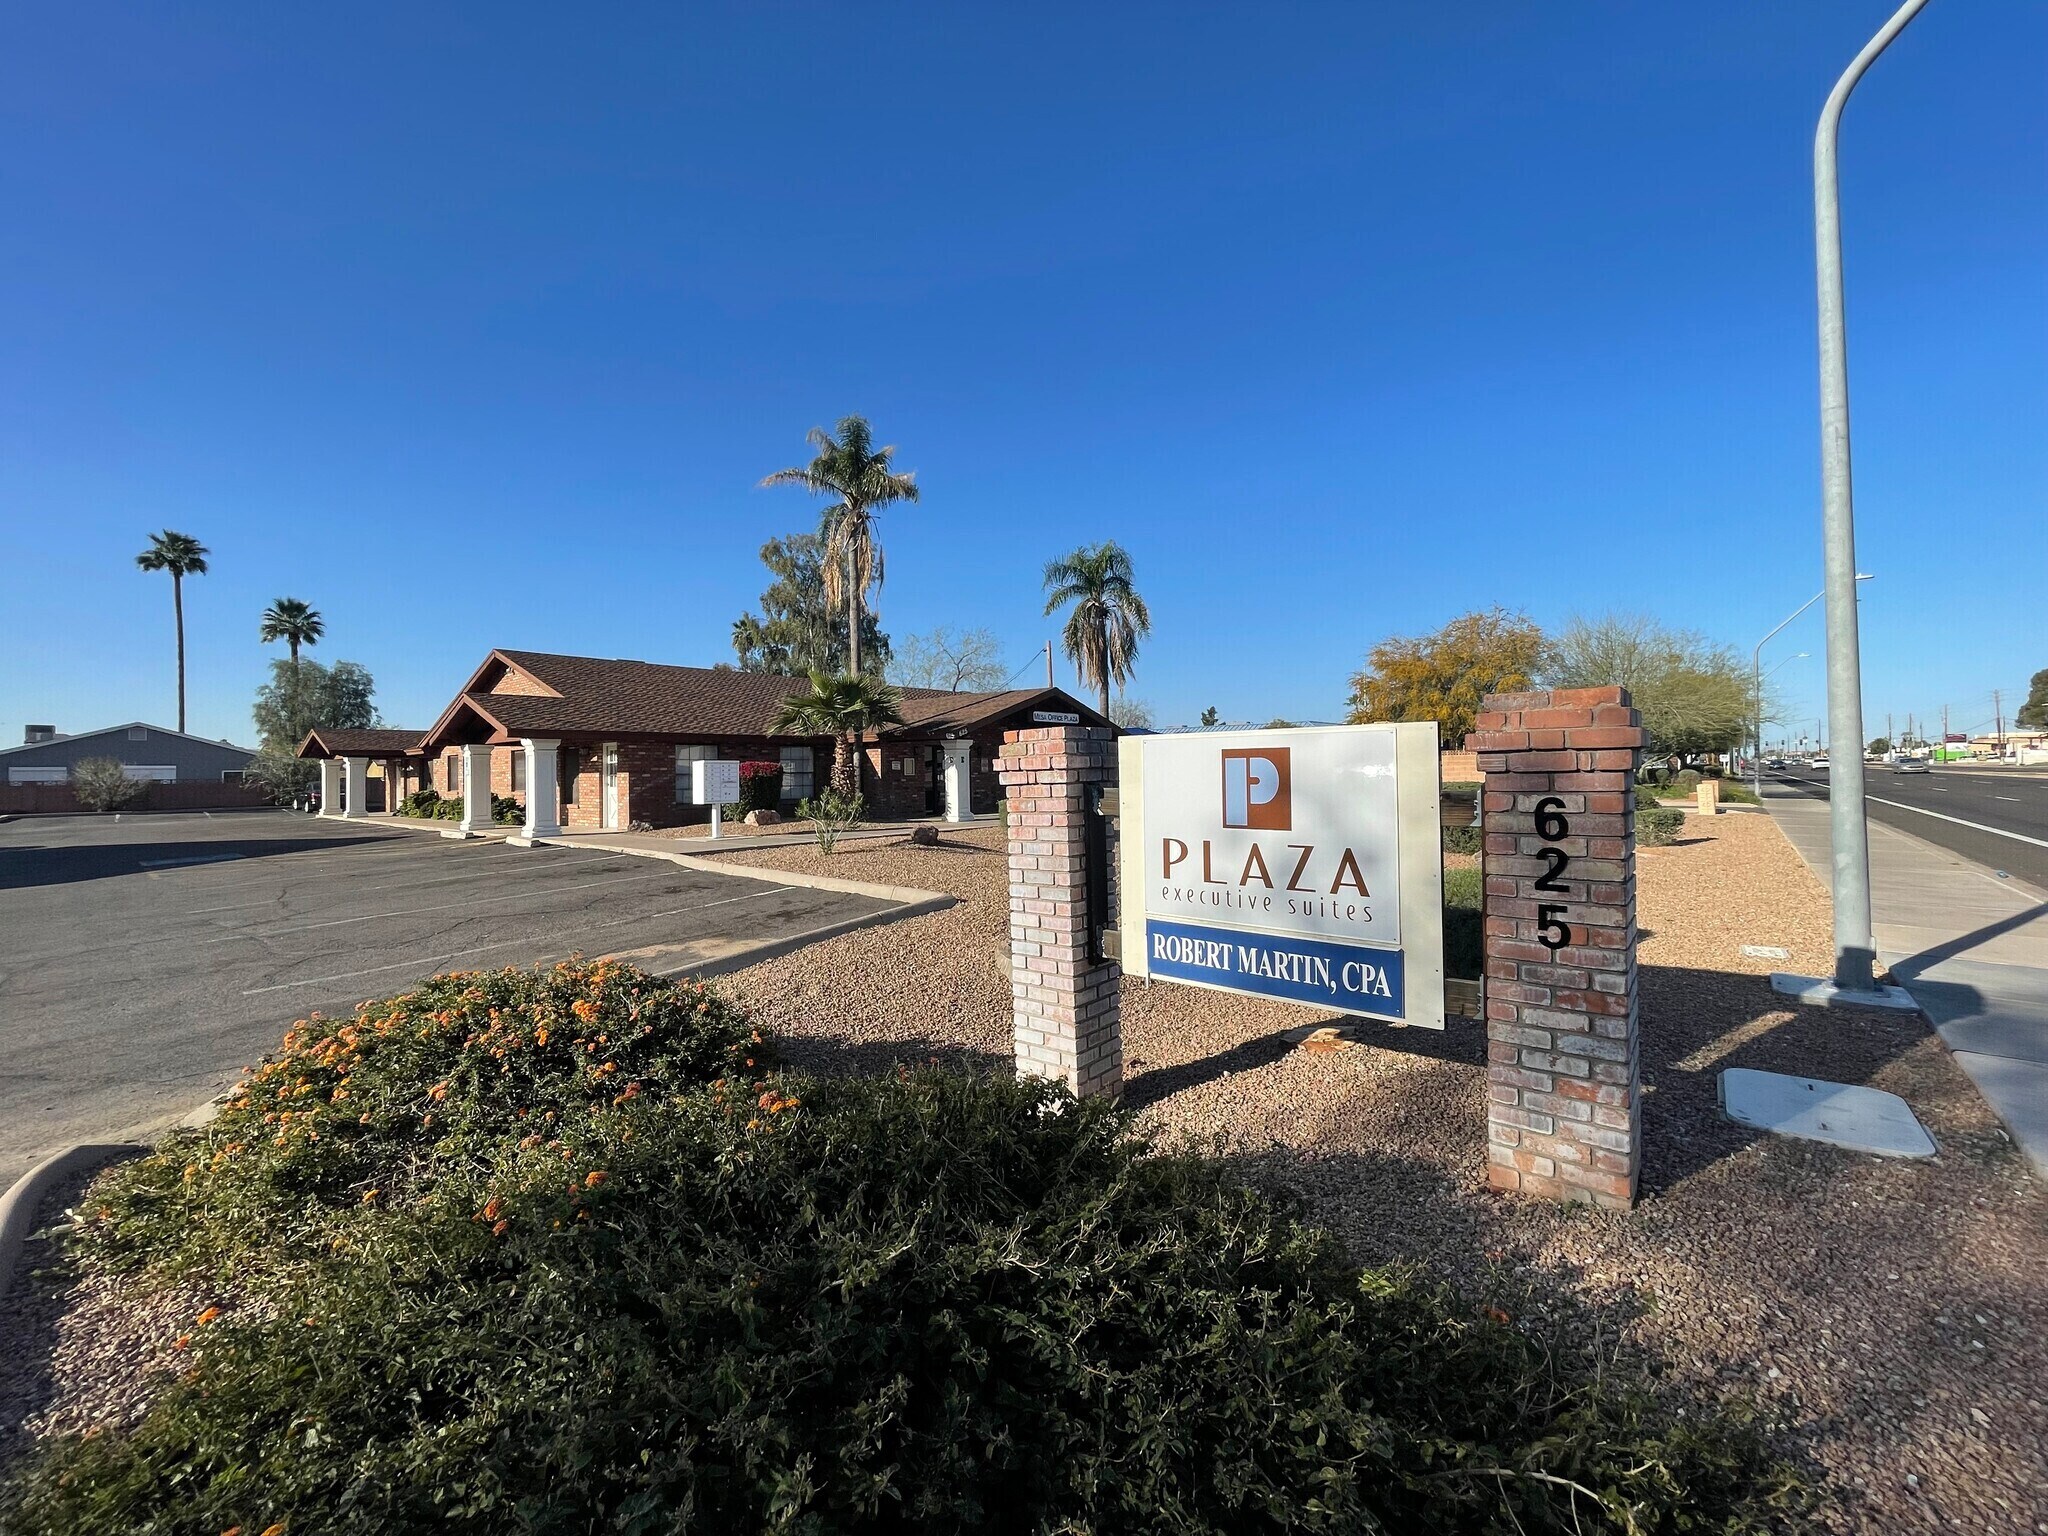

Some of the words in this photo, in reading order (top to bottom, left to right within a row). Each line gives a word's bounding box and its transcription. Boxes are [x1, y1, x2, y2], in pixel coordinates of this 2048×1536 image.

[1162, 838, 1370, 897] PLAZA
[1162, 885, 1271, 912] executive
[1288, 897, 1372, 923] suites
[1153, 933, 1233, 971] ROBERT
[1237, 946, 1337, 995] MARTIN,
[1342, 961, 1392, 998] CPA
